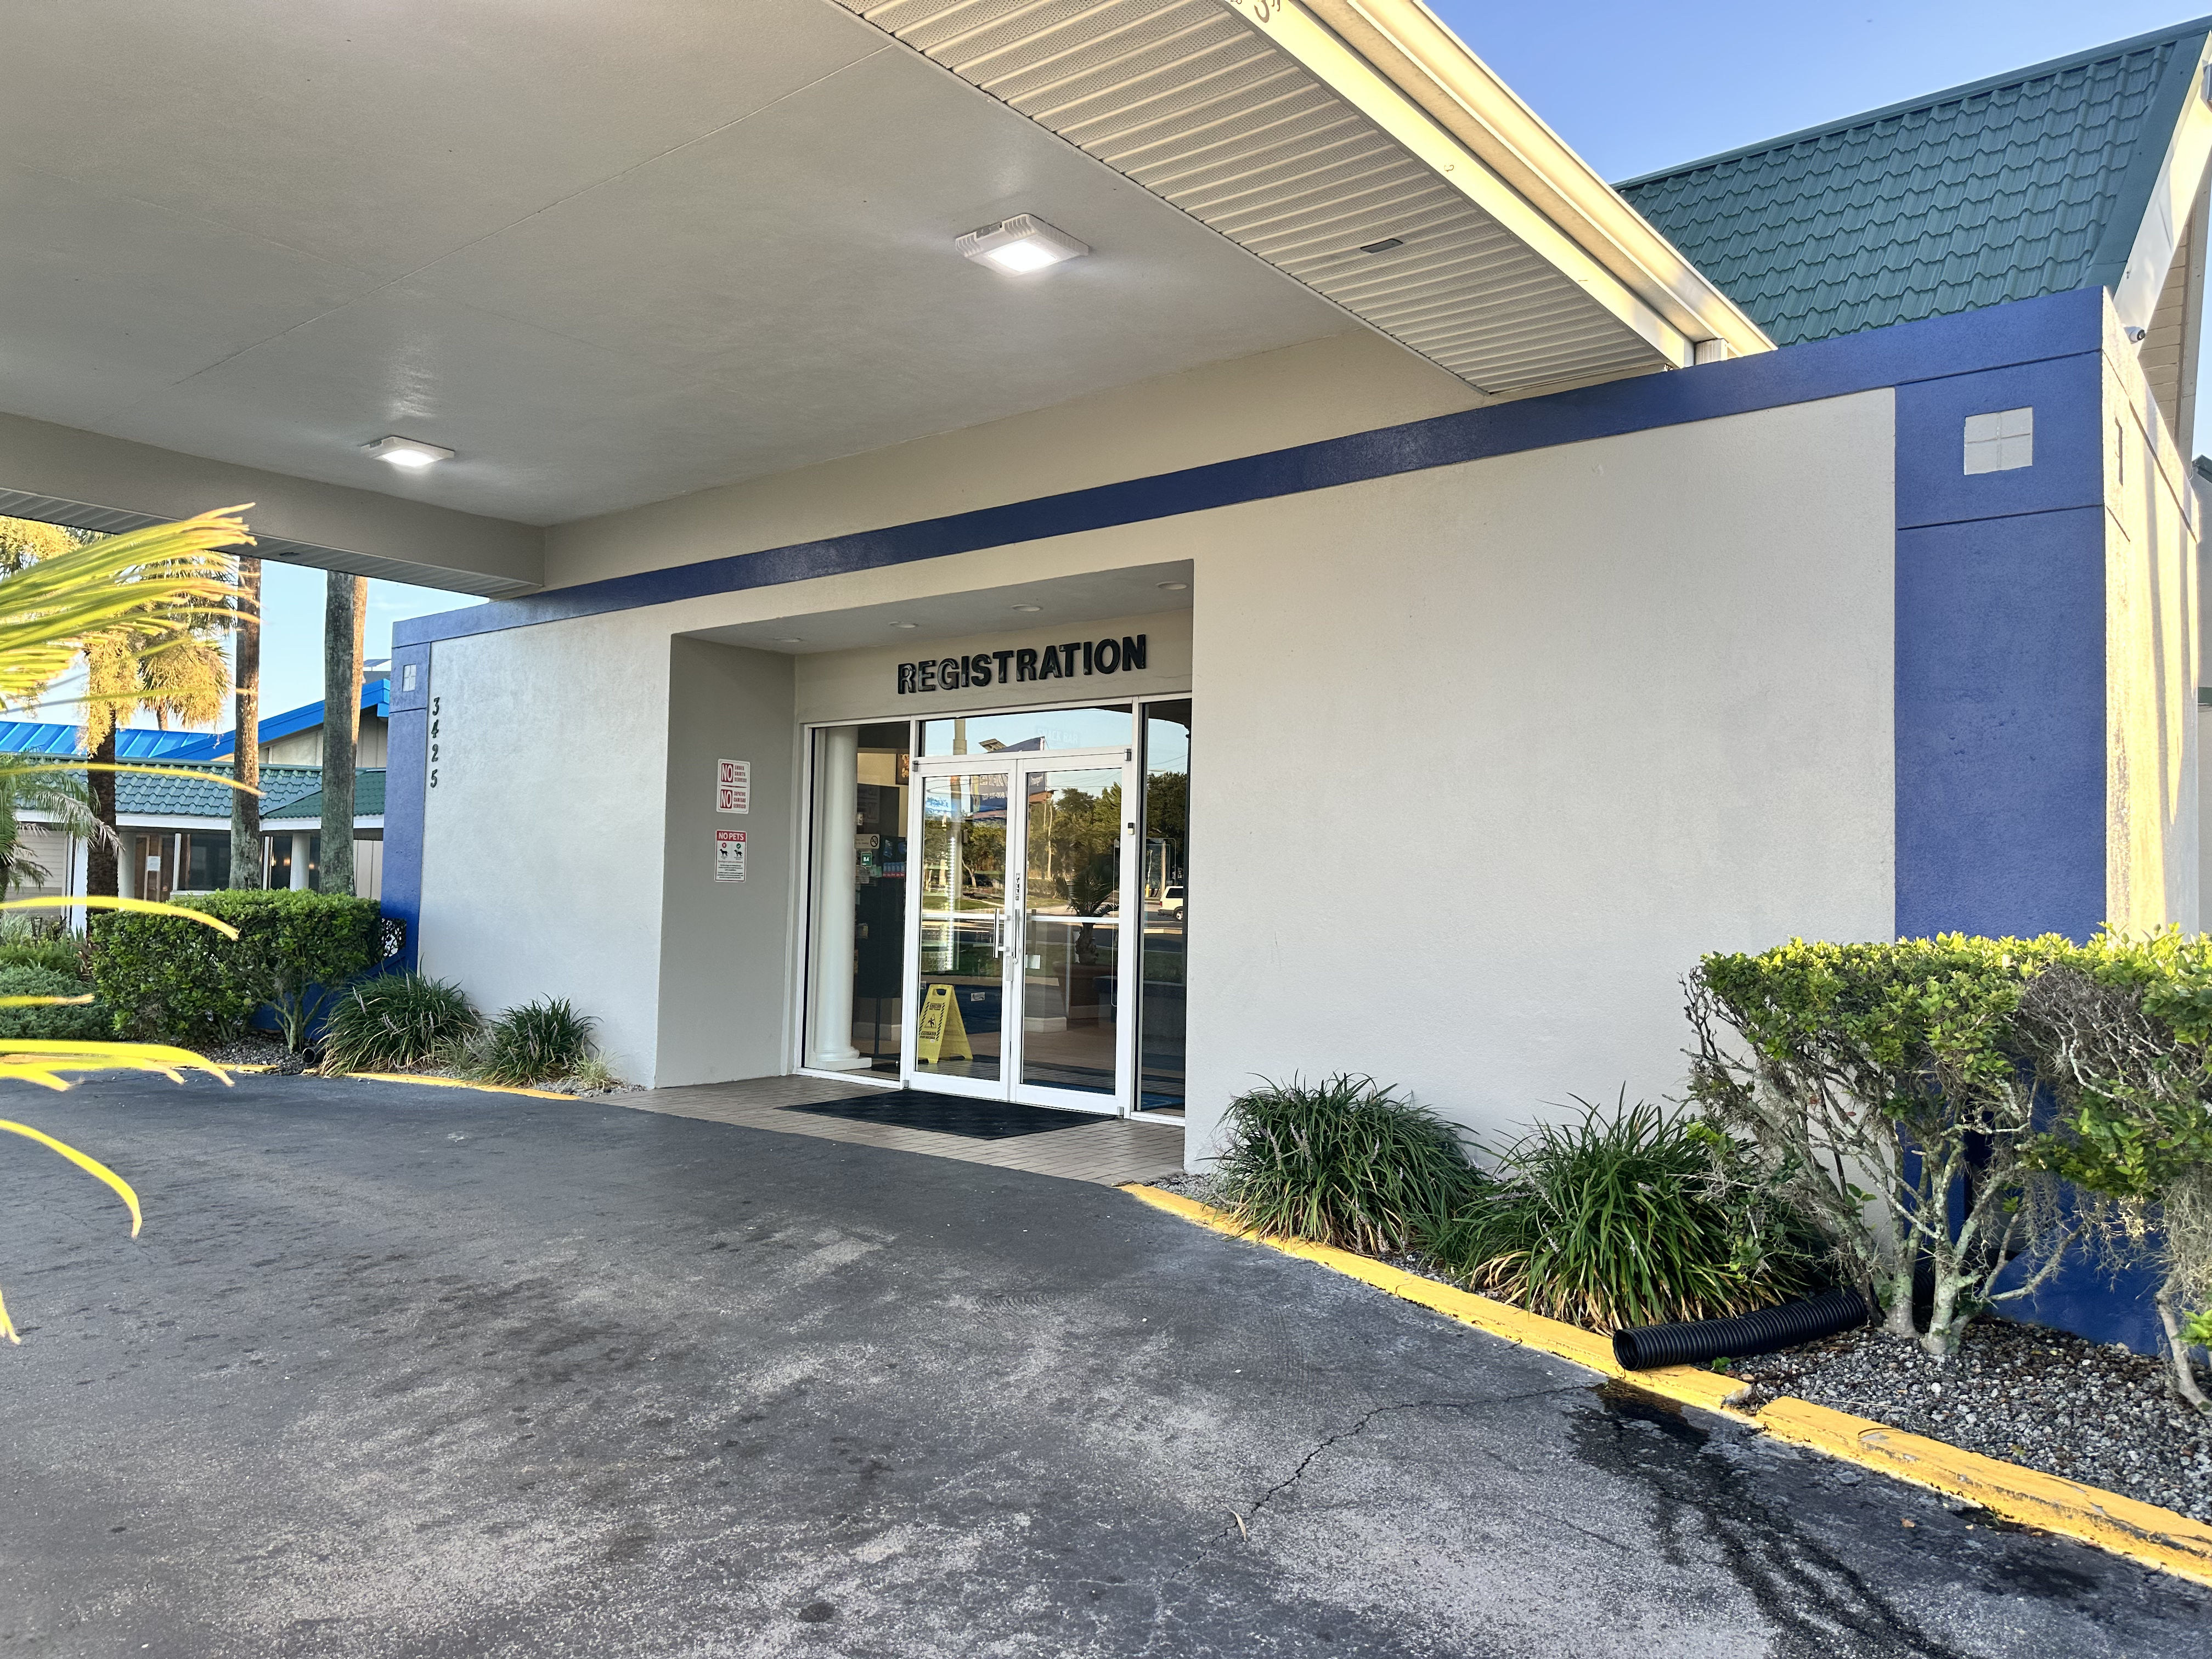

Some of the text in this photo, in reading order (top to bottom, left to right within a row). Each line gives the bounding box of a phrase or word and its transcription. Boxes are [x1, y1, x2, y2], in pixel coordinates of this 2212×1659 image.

[898, 634, 1147, 695] REGISTRATION
[431, 697, 440, 788] 3425
[722, 764, 733, 782] NO
[720, 791, 732, 808] NO
